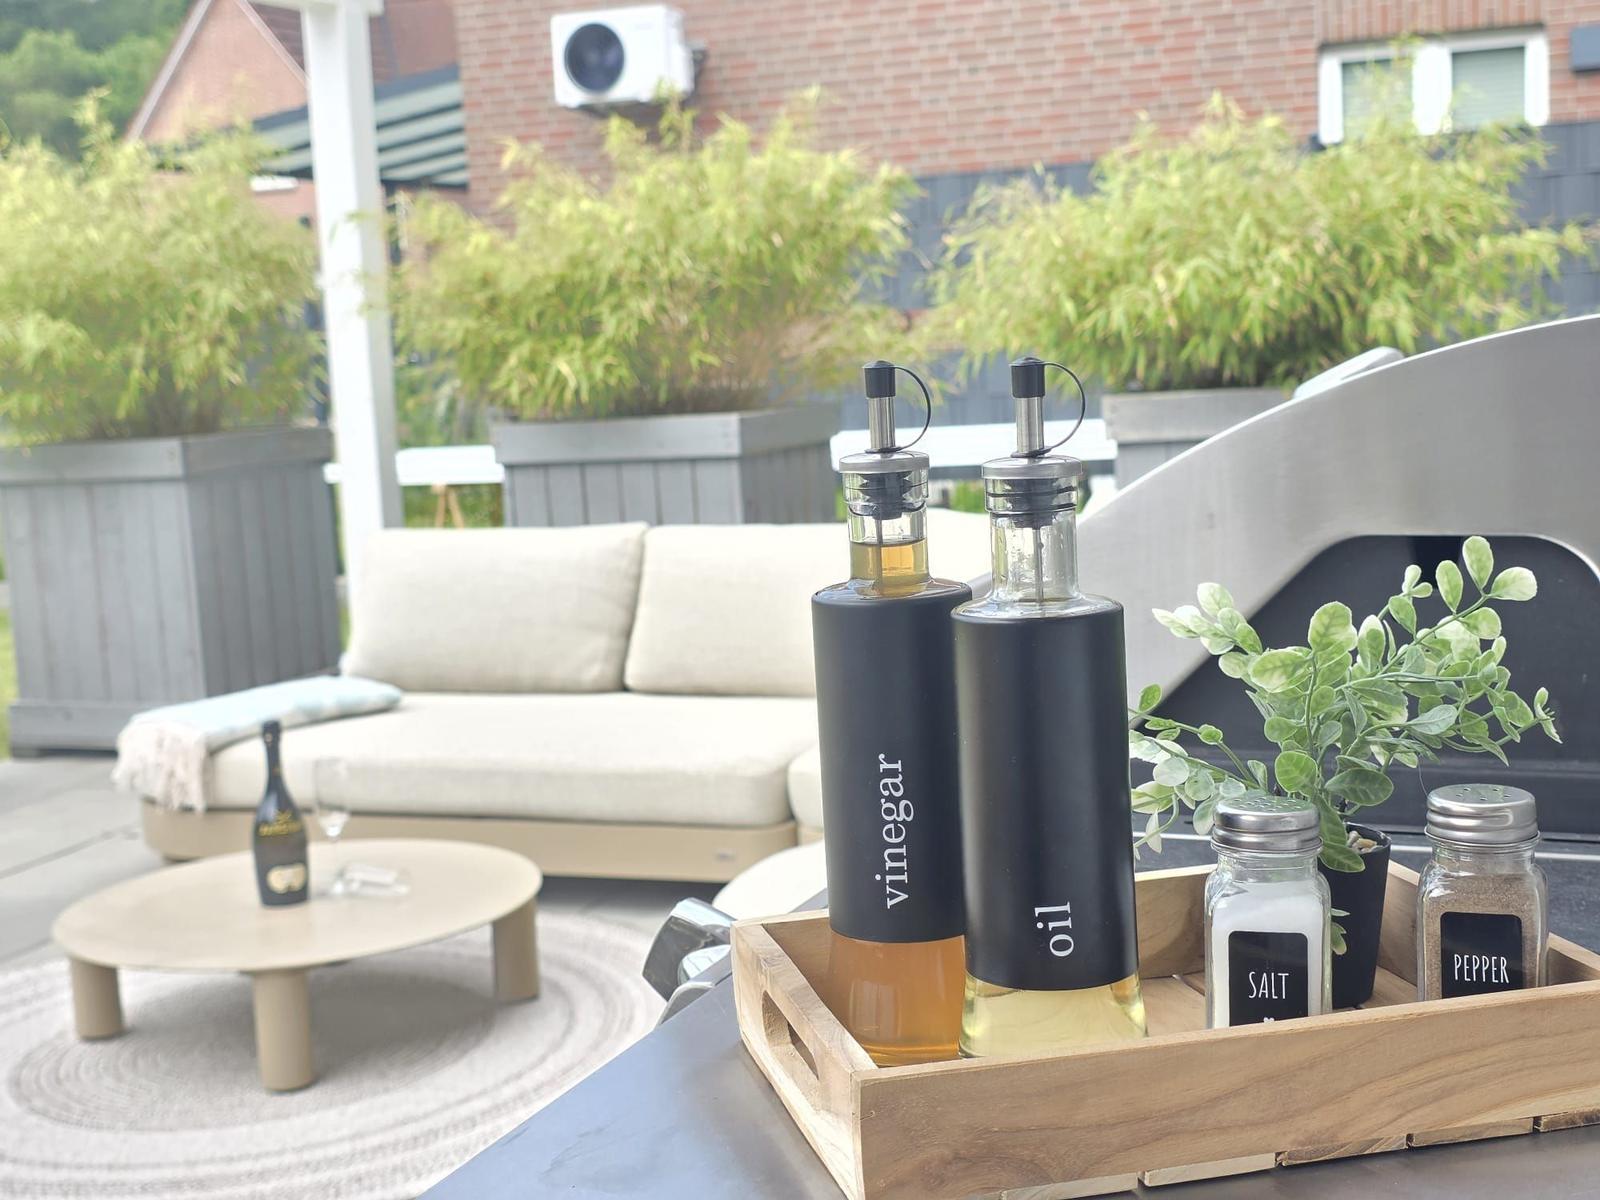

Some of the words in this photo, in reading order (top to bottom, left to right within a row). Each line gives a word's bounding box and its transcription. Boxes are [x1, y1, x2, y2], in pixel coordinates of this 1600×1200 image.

[874, 753, 914, 910] vinegar
[1034, 901, 1075, 957] oil
[1248, 971, 1290, 1000] SALT
[1454, 953, 1510, 984] PEPPER
